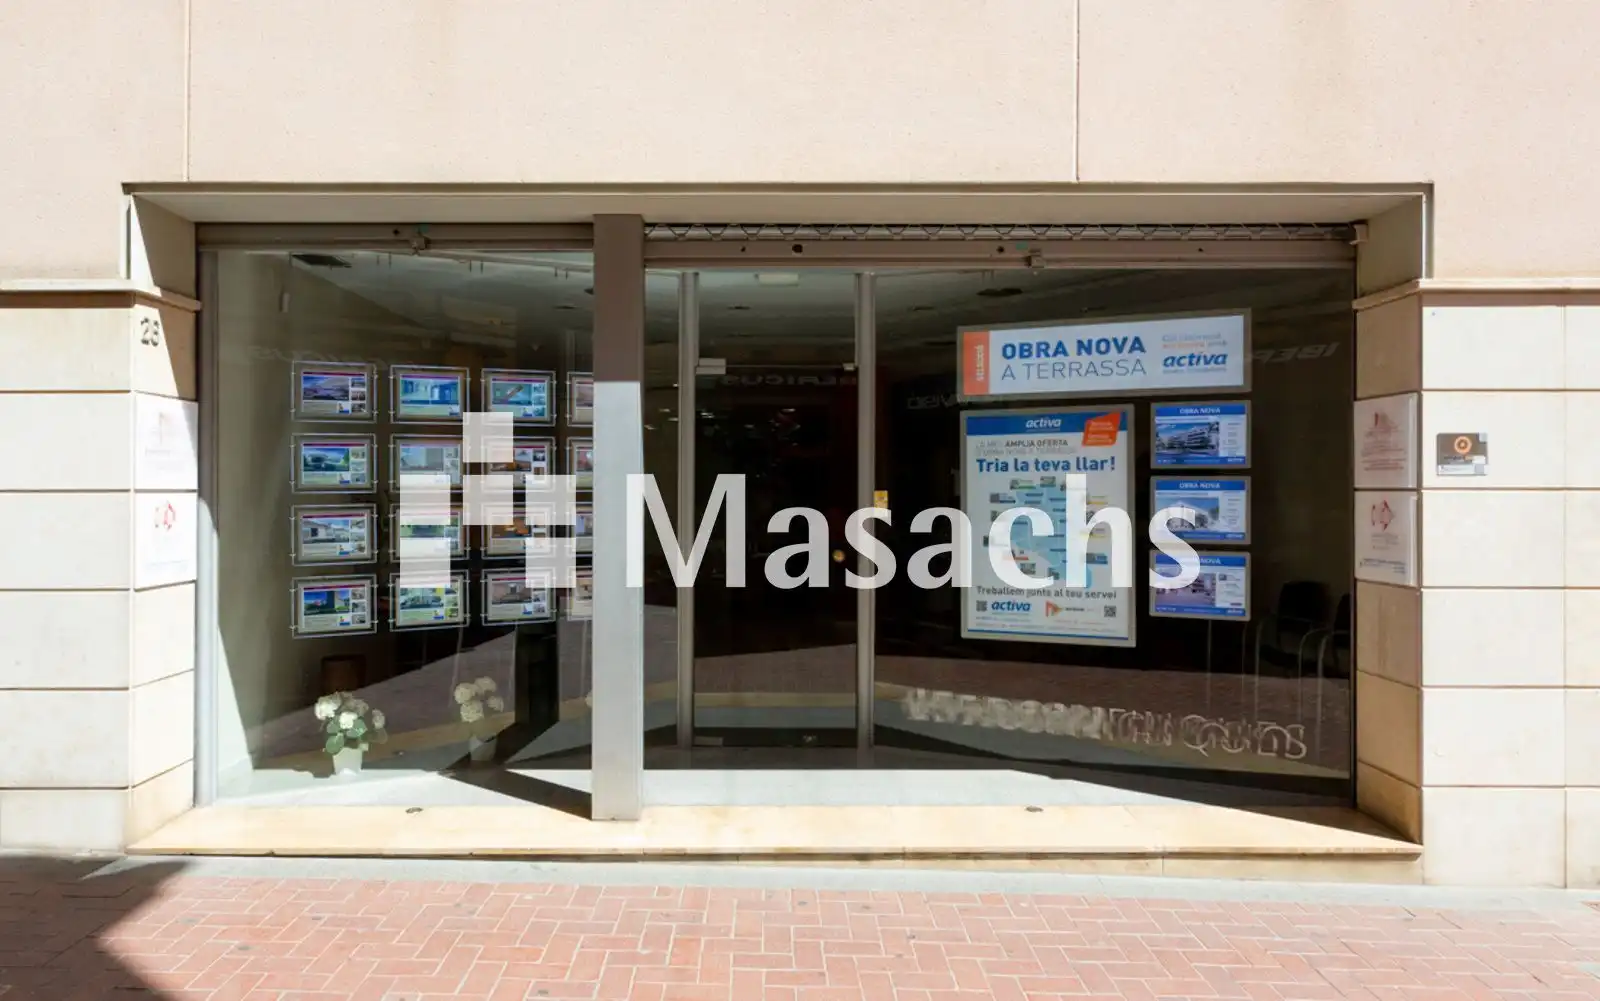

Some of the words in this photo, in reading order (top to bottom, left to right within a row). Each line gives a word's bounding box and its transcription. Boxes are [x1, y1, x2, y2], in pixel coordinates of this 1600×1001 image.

[1001, 339, 1070, 361] OBRA
[1075, 335, 1147, 357] NOVA
[1162, 351, 1228, 368] activa
[1001, 363, 1016, 381] A
[1022, 358, 1147, 380] TERRASSA
[1025, 416, 1062, 429] activa
[976, 457, 1009, 473] Tria
[1014, 457, 1030, 472] la
[1034, 457, 1071, 472] teva
[1076, 456, 1116, 472] llar!
[976, 585, 1024, 597] Treballem
[1085, 589, 1117, 600] servei
[991, 600, 1032, 612] activa
